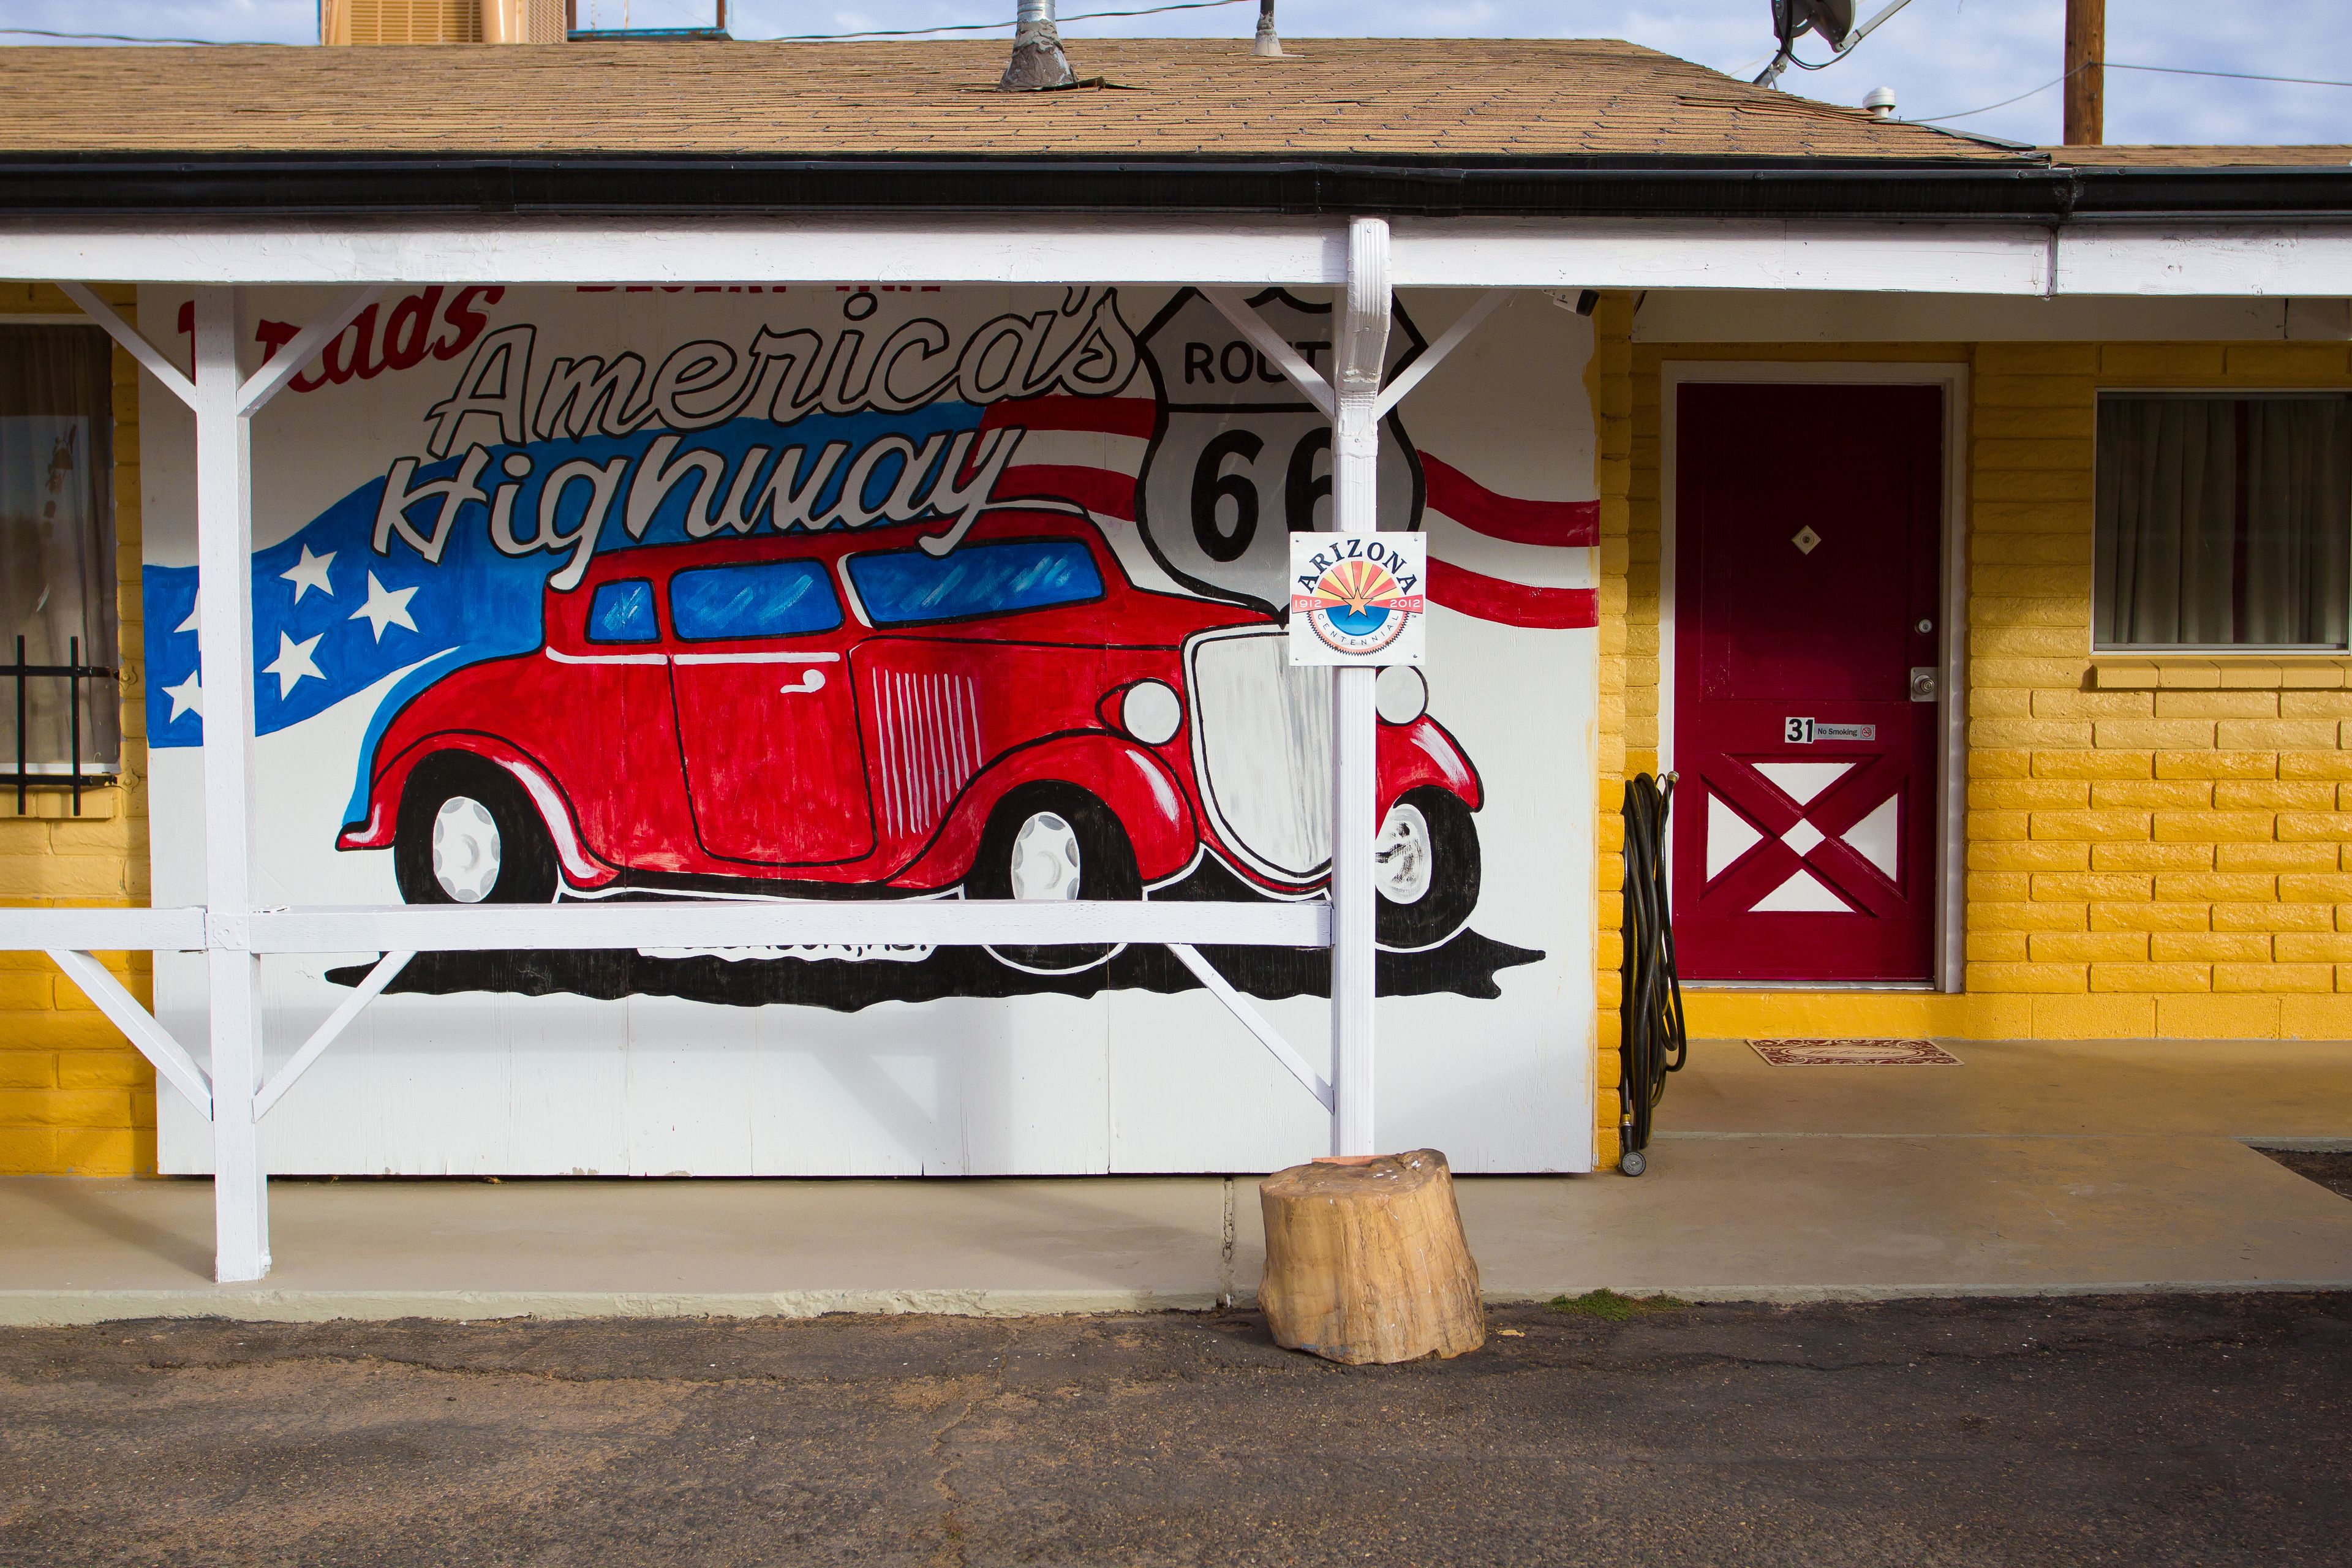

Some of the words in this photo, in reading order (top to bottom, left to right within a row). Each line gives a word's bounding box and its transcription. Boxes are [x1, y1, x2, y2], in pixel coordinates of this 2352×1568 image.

[424, 286, 1139, 461] America's
[1185, 341, 1332, 384] ROUT
[369, 427, 1028, 593] Highway
[1298, 539, 1417, 595] ARIZONA
[1294, 599, 1322, 608] 1912
[1390, 599, 1420, 608] 2012
[1317, 613, 1399, 645] CENTENNIAL
[1787, 718, 1814, 742] 31
